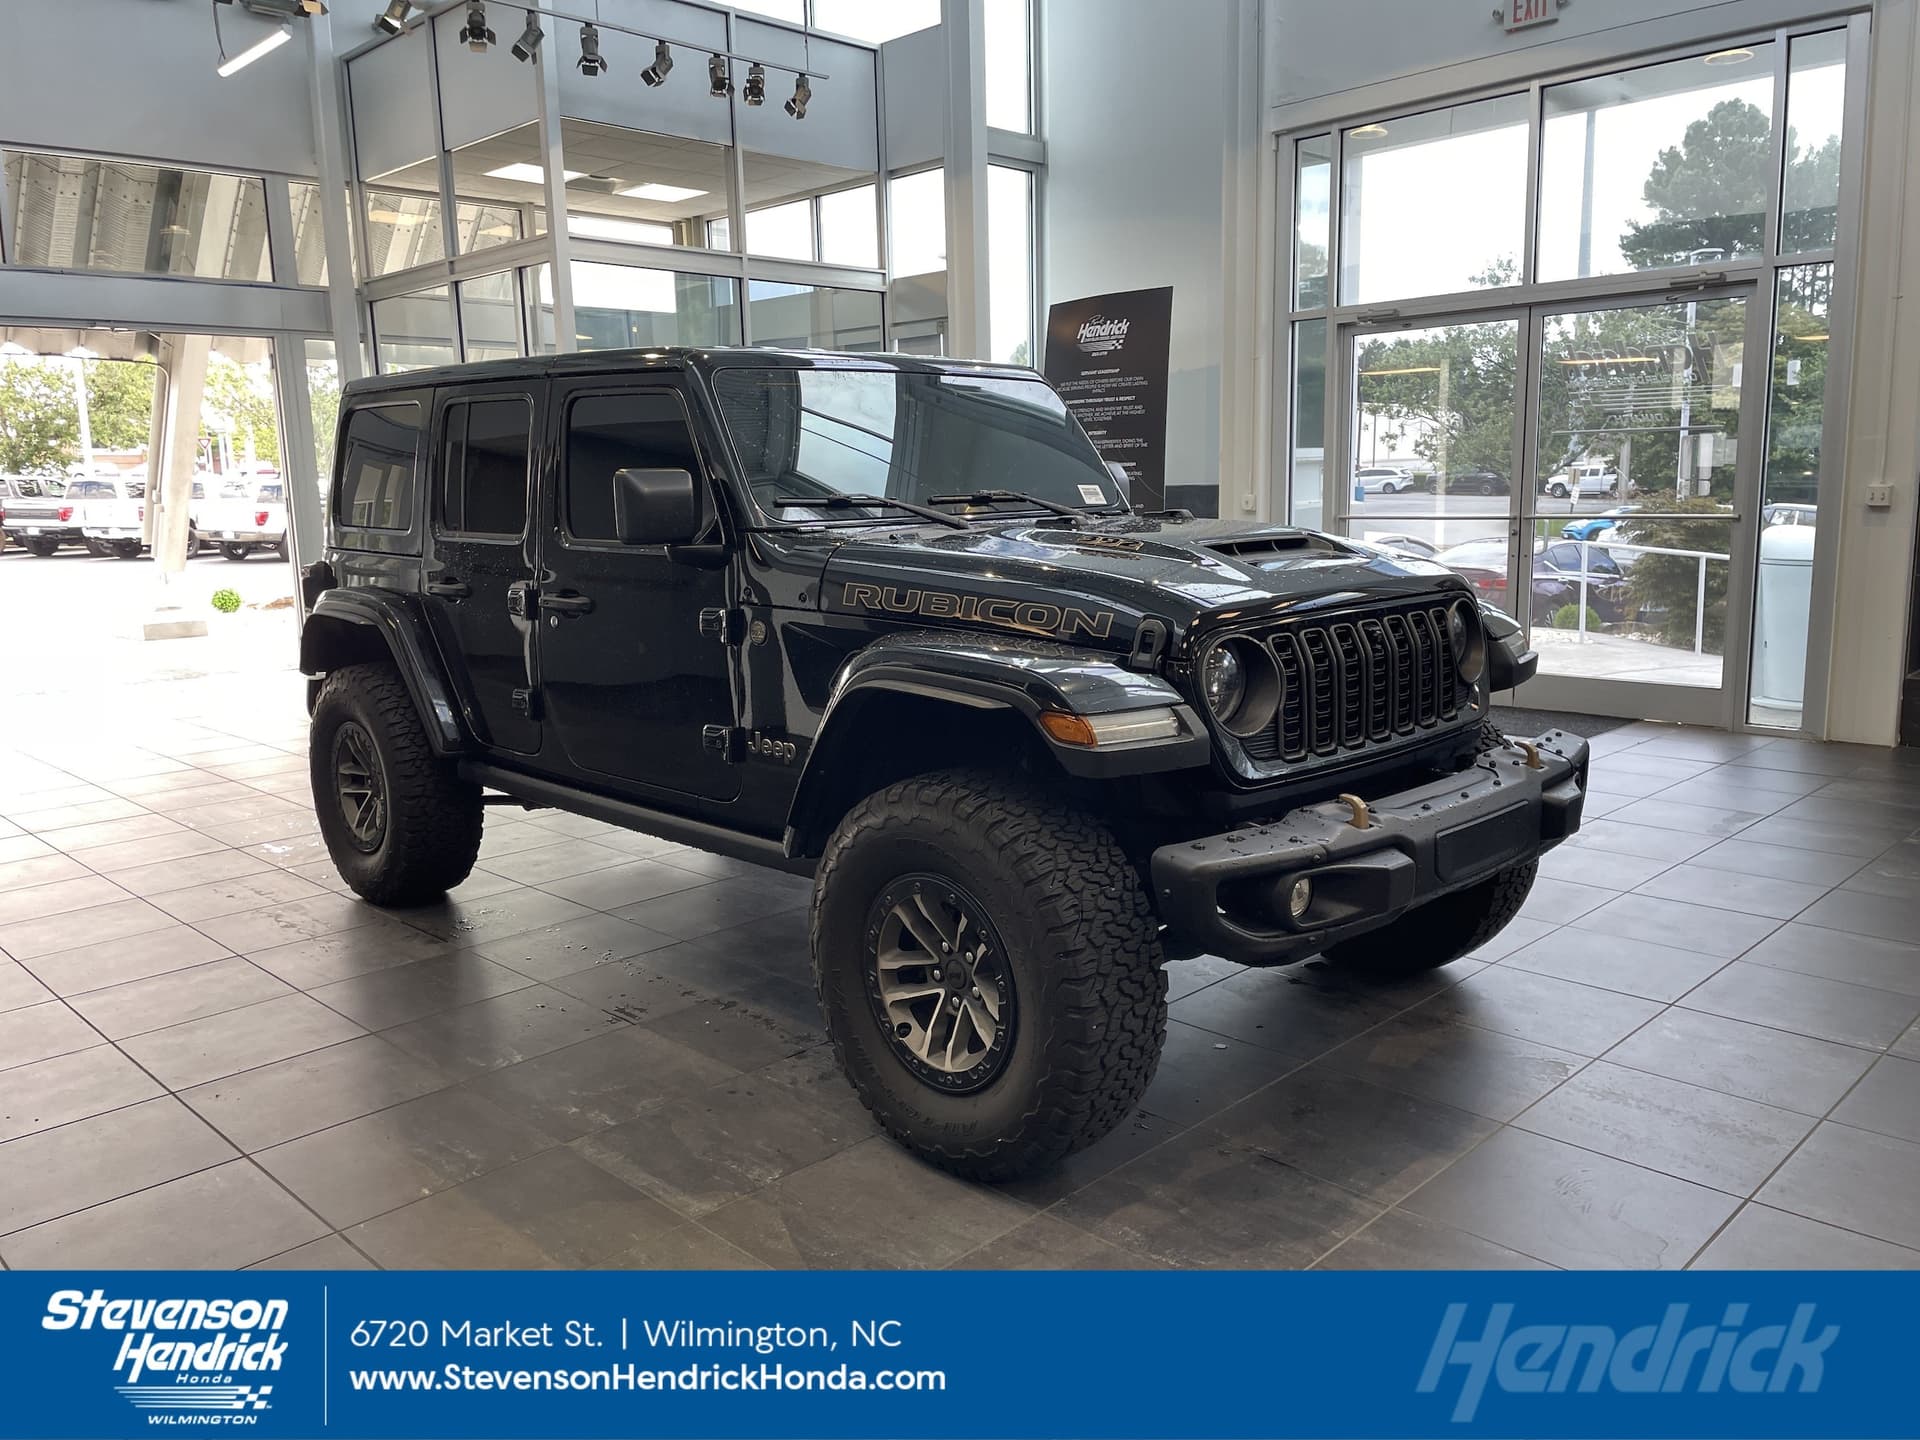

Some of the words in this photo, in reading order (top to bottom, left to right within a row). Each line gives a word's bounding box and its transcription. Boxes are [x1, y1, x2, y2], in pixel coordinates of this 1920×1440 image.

[1077, 318, 1130, 343] Hendrick
[842, 582, 1115, 638] RUBICON
[747, 731, 797, 765] Jeep
